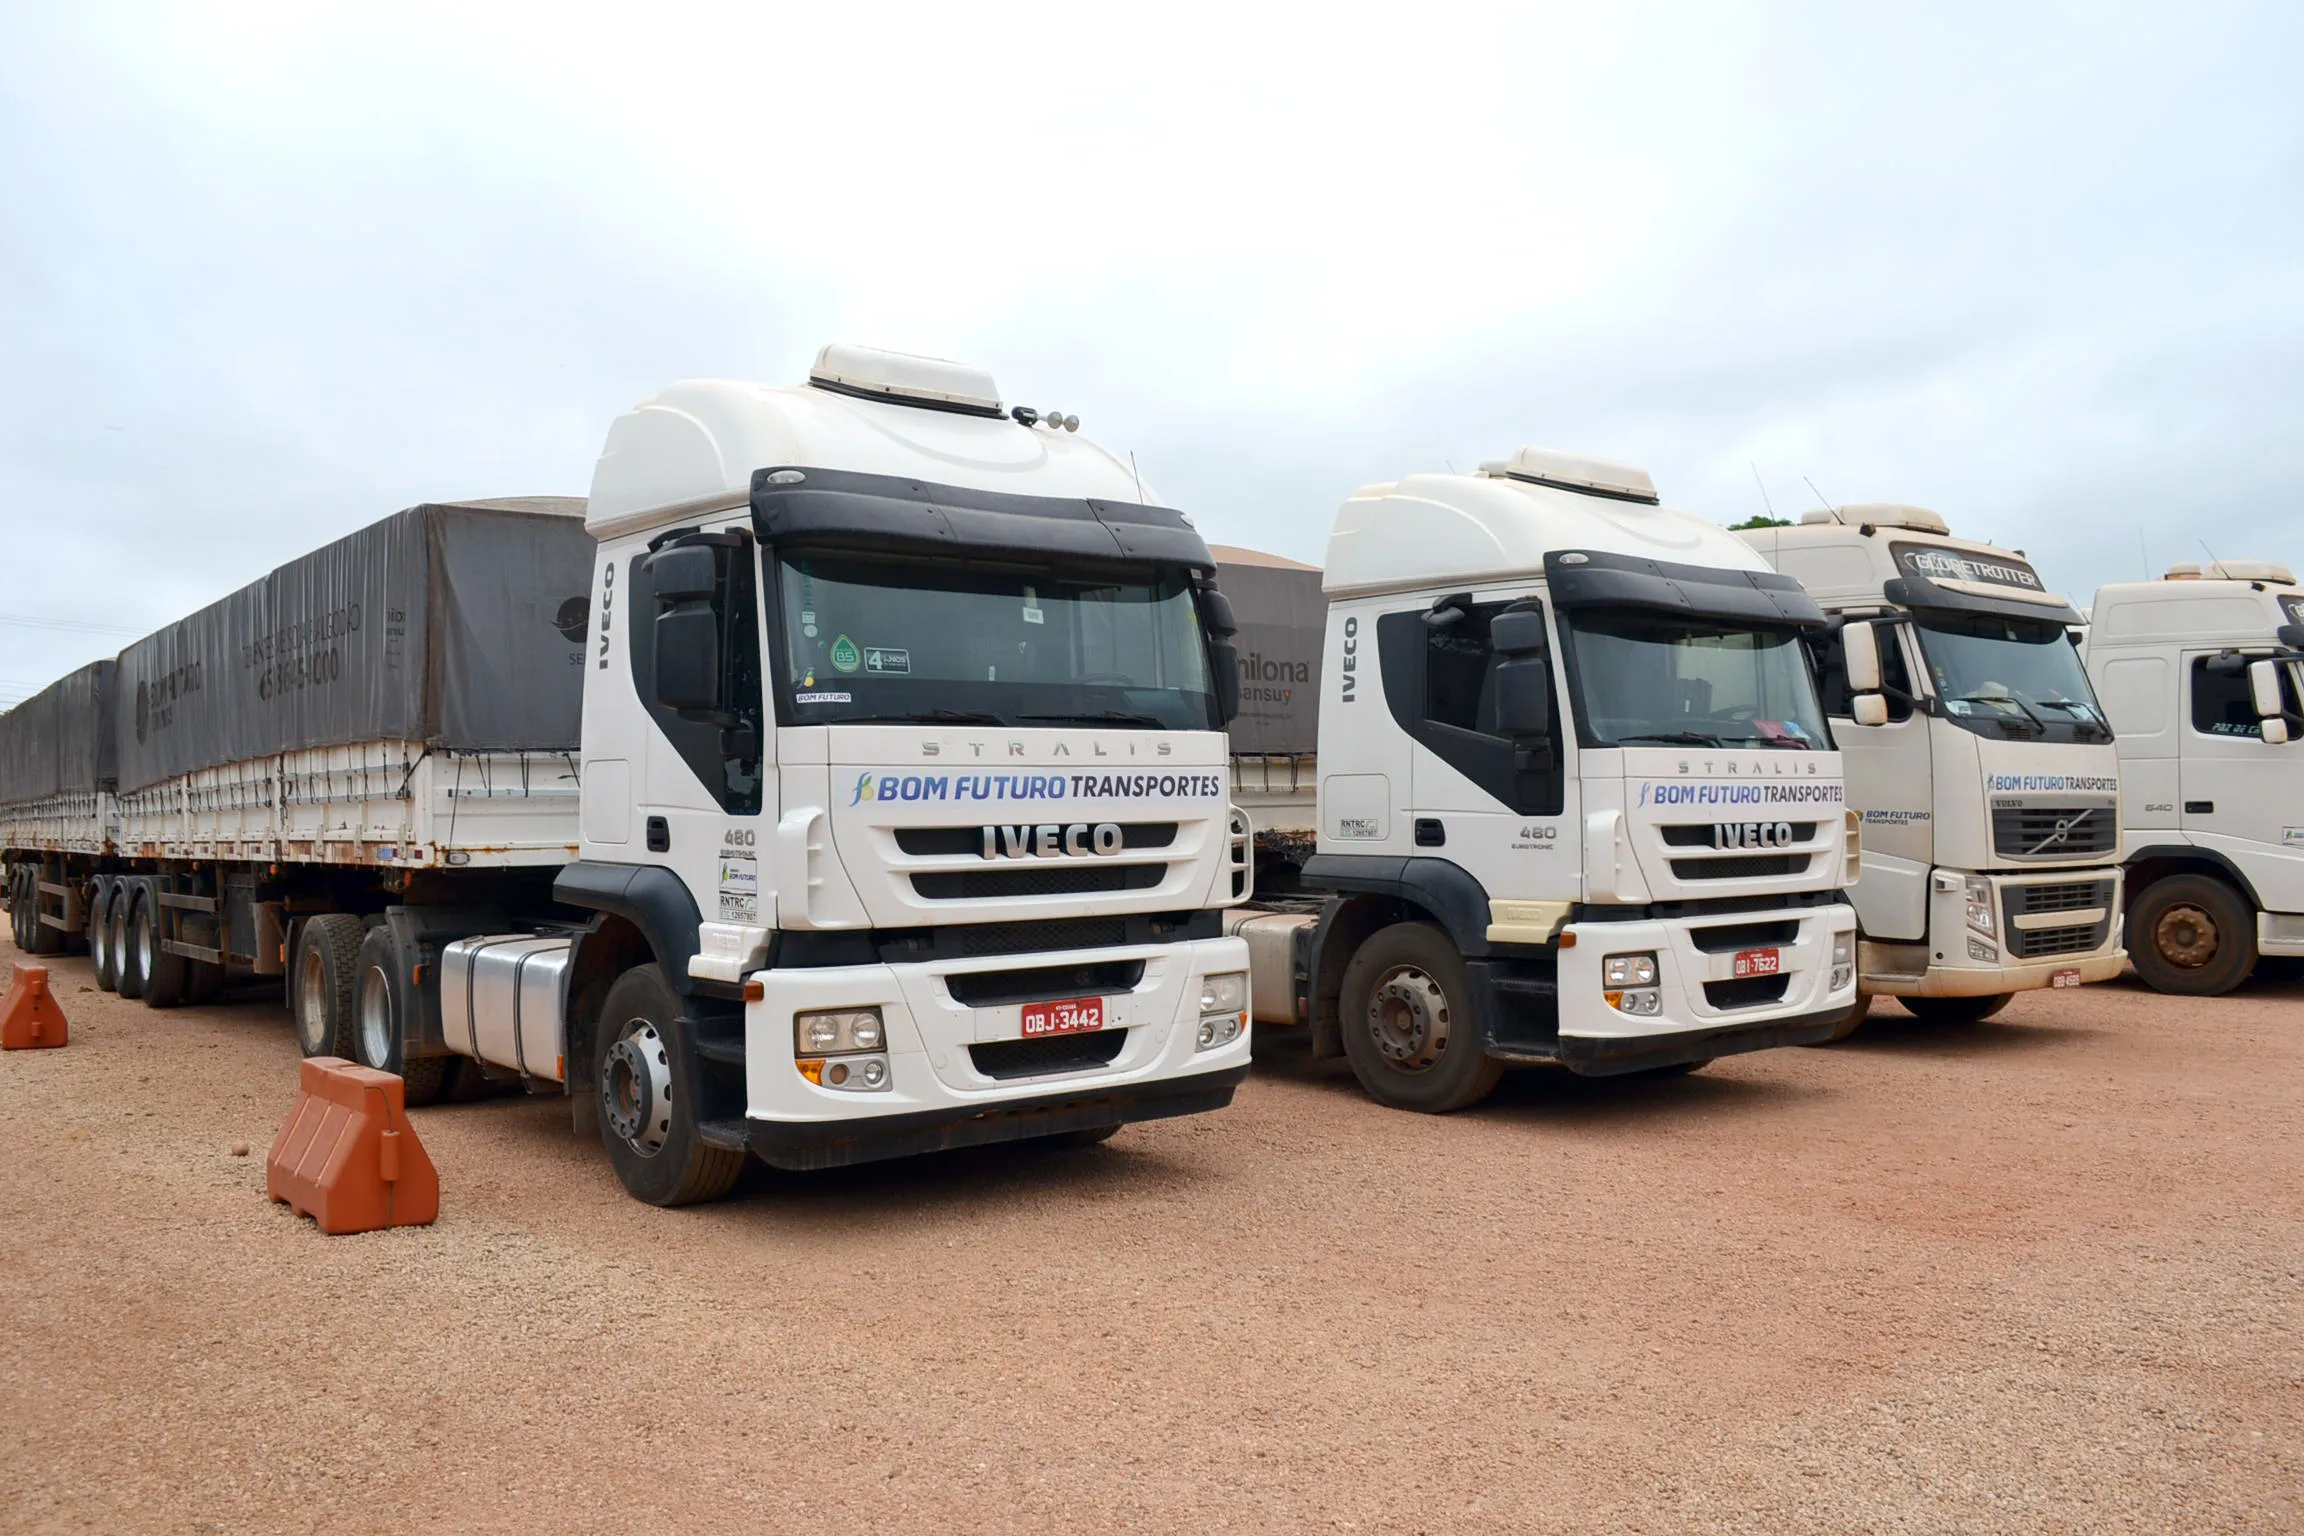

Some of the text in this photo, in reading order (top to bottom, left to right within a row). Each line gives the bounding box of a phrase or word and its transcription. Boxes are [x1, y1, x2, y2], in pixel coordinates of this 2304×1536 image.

[599, 561, 615, 670] IVECO
[568, 652, 586, 666] SE
[868, 650, 883, 670] 4
[1237, 652, 1309, 683] nilona
[1342, 616, 1358, 703] IVECO
[818, 693, 850, 701] FUTURO
[1239, 687, 1292, 706] ansuy
[921, 740, 1172, 757] STRALIS
[1678, 761, 1817, 775] STRALIS
[877, 775, 1220, 801] BOM FUTURO TRANSPORTES
[1995, 775, 2117, 791] BOM FUTURO TRANSPORTES
[1654, 785, 1843, 804] BOM FUTURO TRANSPORTES
[1866, 810, 1930, 820] BOM FUTURO
[724, 828, 756, 847] 480
[981, 822, 1124, 860] IVECO
[1520, 826, 1557, 839] 480
[1713, 822, 1793, 851] IVECO
[720, 895, 745, 908] RNTRC
